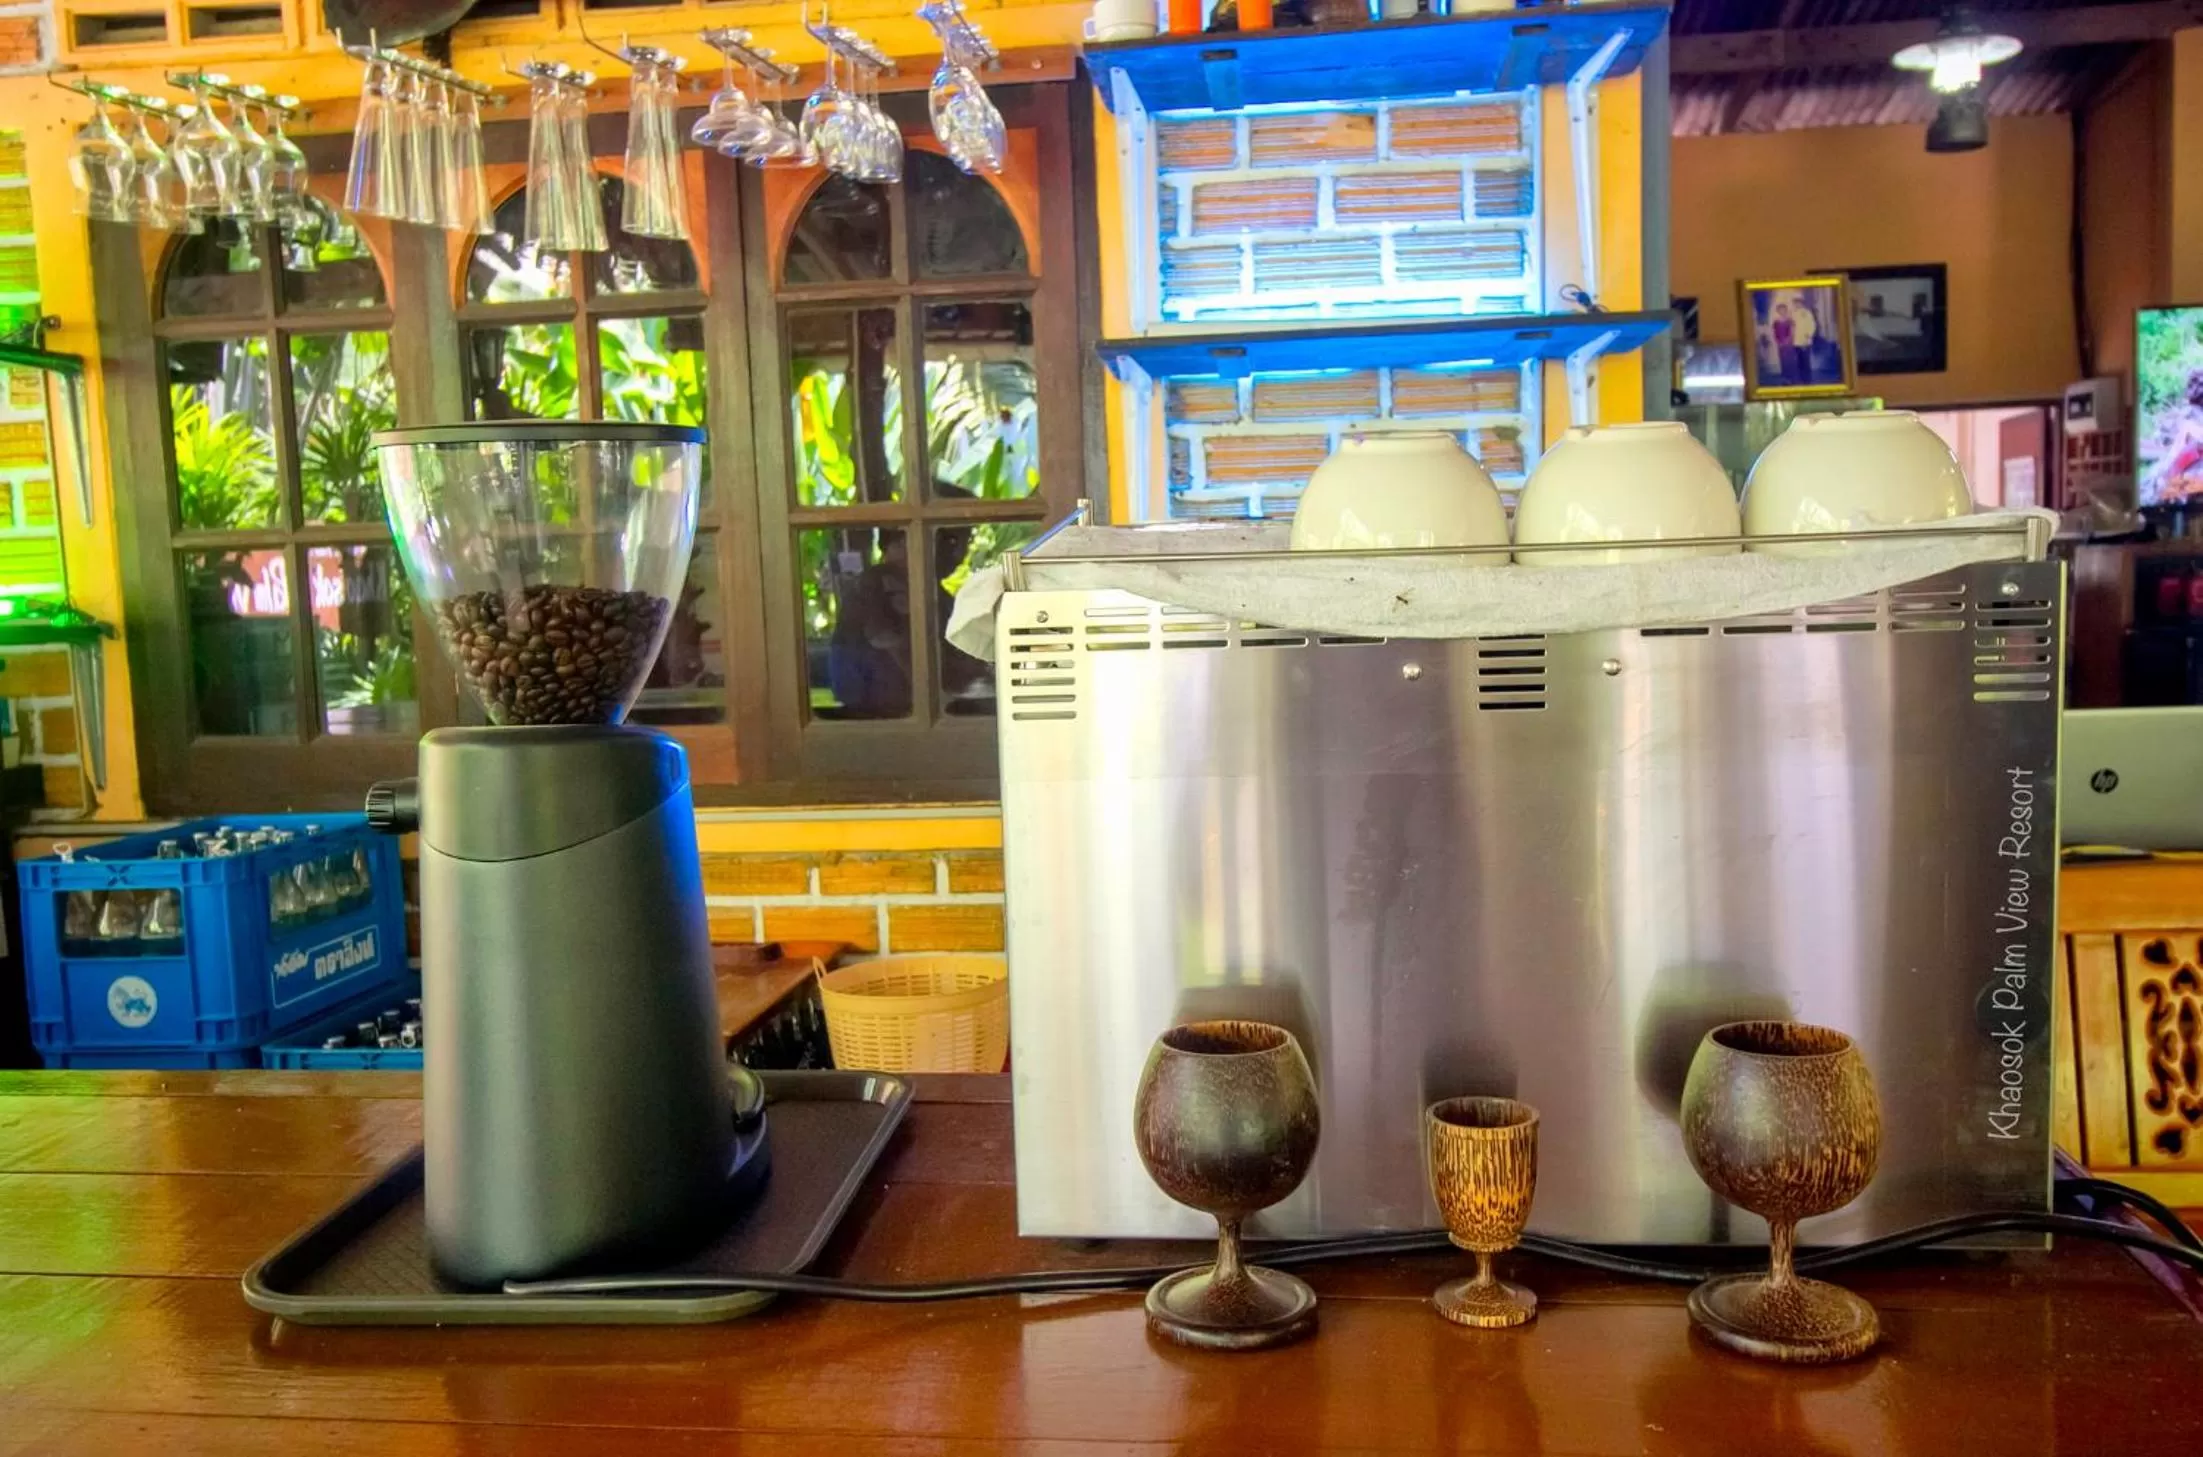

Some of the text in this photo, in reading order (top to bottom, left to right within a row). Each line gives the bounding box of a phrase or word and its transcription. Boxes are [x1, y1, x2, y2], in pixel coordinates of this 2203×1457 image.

[1987, 766, 2033, 1139] Khaosok Palm View Resort
